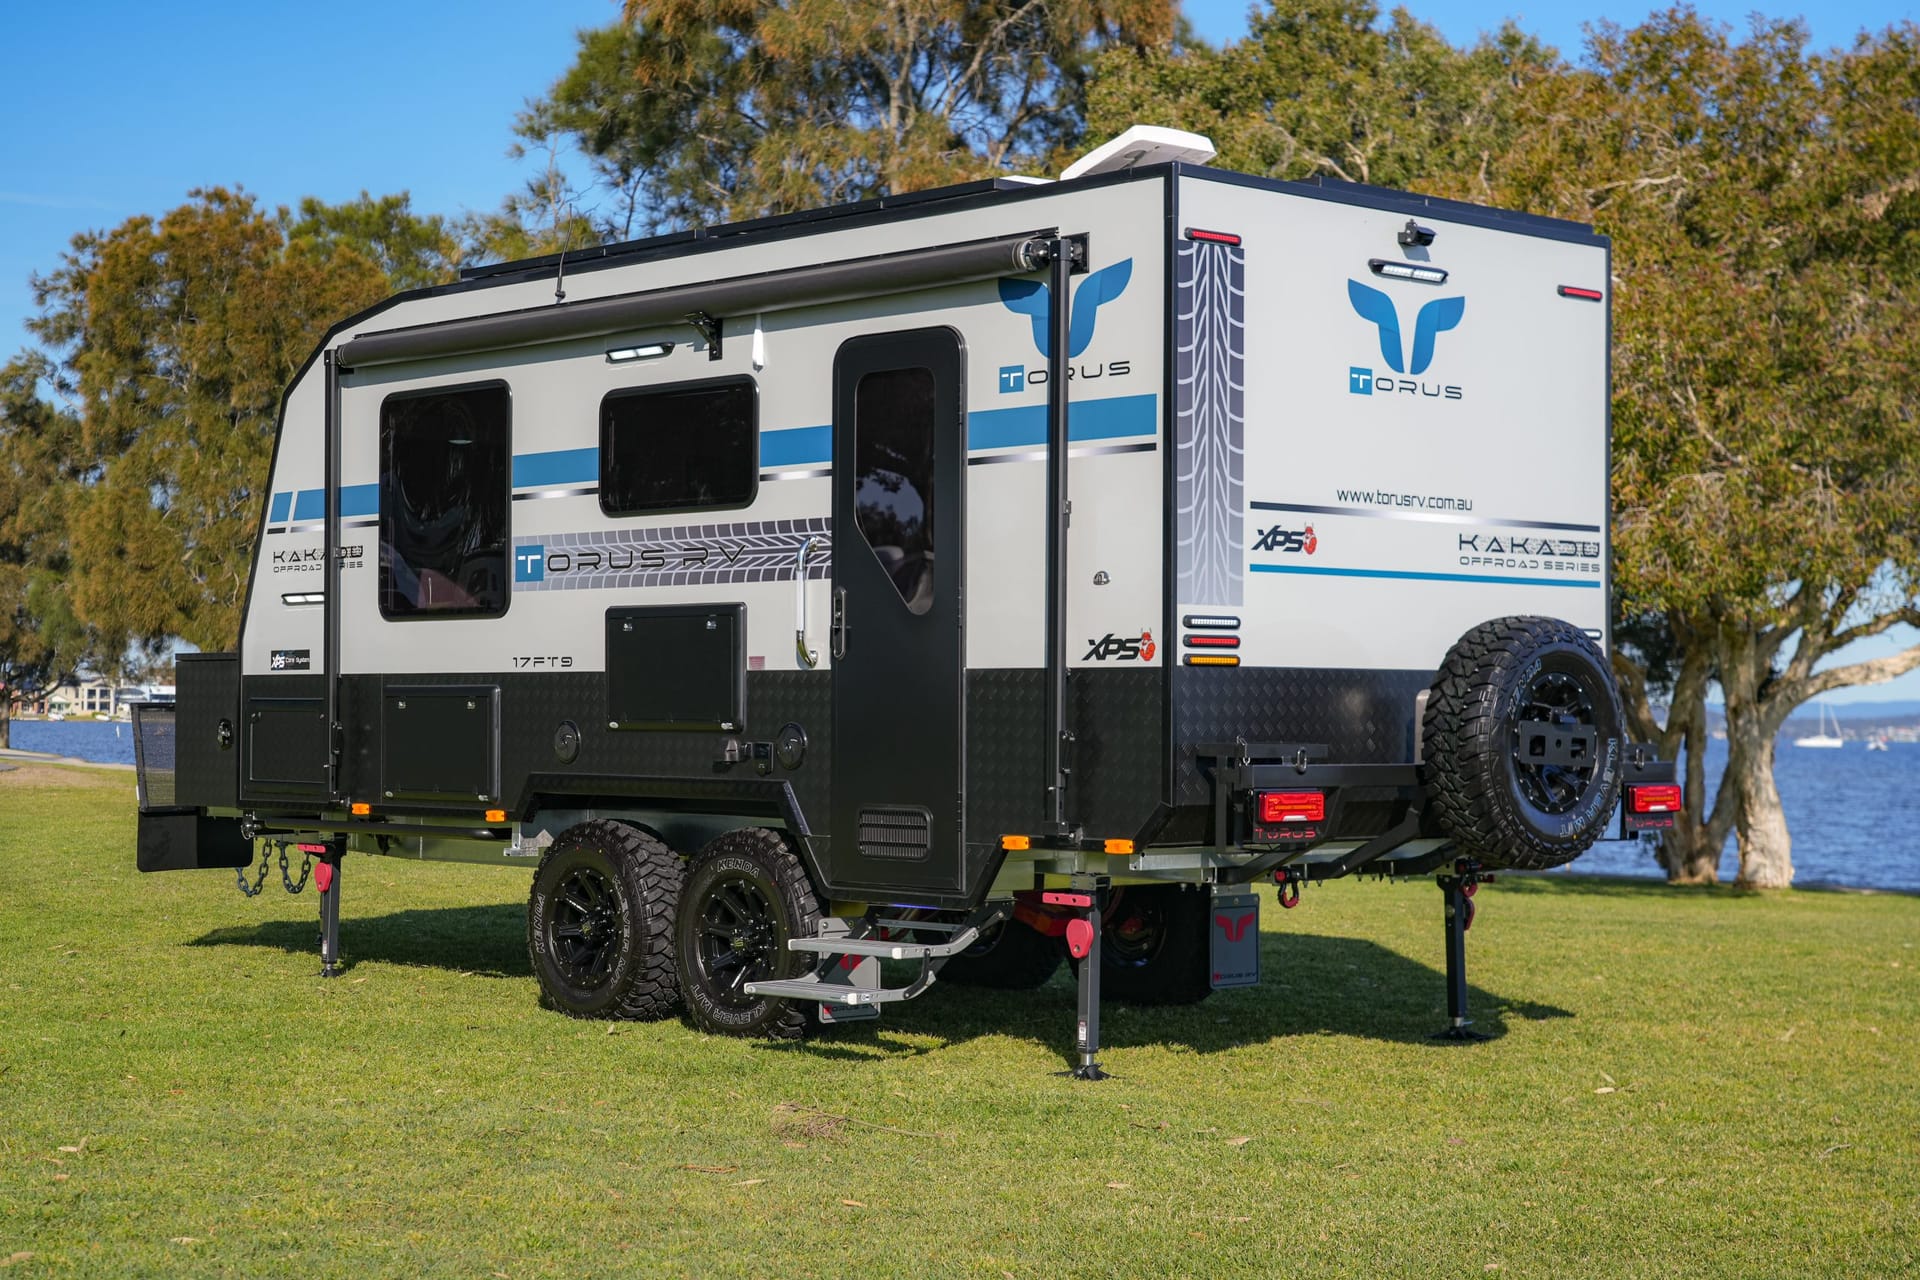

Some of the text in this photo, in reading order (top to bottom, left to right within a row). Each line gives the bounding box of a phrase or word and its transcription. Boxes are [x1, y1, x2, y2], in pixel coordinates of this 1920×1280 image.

[1351, 373, 1463, 400] TORUS
[1336, 489, 1473, 511] www.torusrv.com.au
[1251, 525, 1305, 553] XPS
[1459, 533, 1600, 558] KAKADU
[273, 563, 322, 573] OFFROAD
[517, 544, 746, 574] TORUS RV
[1459, 556, 1600, 573] OFFROAD SERIES
[1081, 633, 1142, 661] XPS
[271, 653, 285, 669] XPS
[512, 656, 574, 668] 17FT9
[1255, 827, 1317, 840] TORUS
[717, 857, 761, 879] KENDA
[533, 893, 546, 954] KENDA
[612, 873, 631, 953] KLEVER
[713, 1000, 767, 1025] KLEVER
